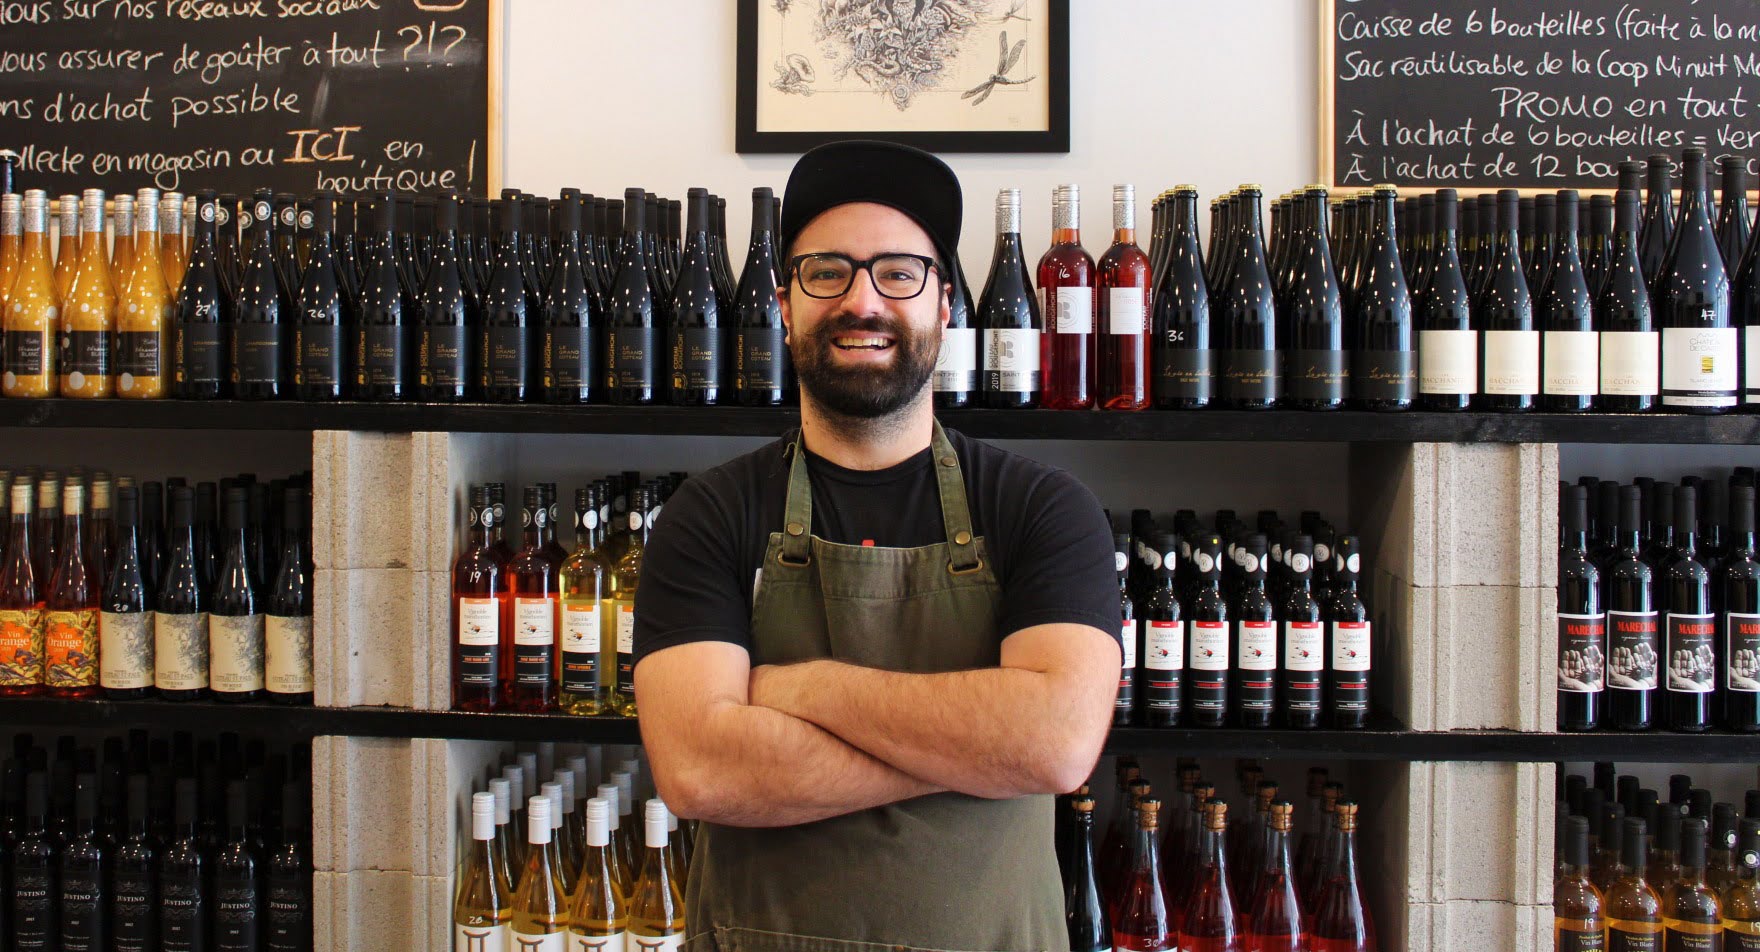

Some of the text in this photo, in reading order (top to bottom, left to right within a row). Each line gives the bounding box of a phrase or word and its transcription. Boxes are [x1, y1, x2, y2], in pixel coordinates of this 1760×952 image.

[63, 0, 101, 20] sur
[114, 0, 157, 19] nos
[1338, 11, 1413, 41] Caisse
[1418, 12, 1452, 36] de
[1465, 9, 1483, 34] 6
[1490, 7, 1607, 38] bouteilles
[1689, 16, 1707, 38] à
[1713, 13, 1733, 41] la
[58, 49, 165, 71] assurer
[172, 42, 201, 75] de
[201, 35, 292, 85] goûter
[302, 39, 322, 66] à
[326, 29, 387, 69] tout
[1339, 50, 1385, 81] Sac
[1390, 51, 1529, 77] réutilisable
[1535, 51, 1563, 76] de
[1571, 49, 1592, 74] la
[1596, 49, 1649, 88] Coop
[1655, 53, 1728, 79] Minuit
[44, 86, 154, 122] d'achat
[171, 82, 301, 129] possible
[1490, 86, 1748, 123] PROMO en tout
[1345, 109, 1371, 146] À
[1381, 117, 1478, 146] l'achat
[1481, 122, 1517, 145] de
[1527, 123, 1550, 146] 6
[1555, 123, 1686, 148] bouteilles
[91, 152, 122, 176] en
[128, 147, 231, 191] magasin
[240, 147, 275, 166] ou
[383, 140, 424, 161] en
[1343, 152, 1373, 184] À
[1382, 152, 1477, 180] l'achat
[1482, 151, 1520, 177] de
[1529, 152, 1568, 177] 12
[1058, 267, 1071, 280] 16
[195, 303, 212, 317] 27
[307, 308, 326, 319] 26
[1167, 329, 1184, 342] 36
[991, 372, 999, 390] 2019
[469, 571, 482, 584] 19
[270, 901, 298, 909] JUSTINO
[1584, 918, 1594, 930] 19
